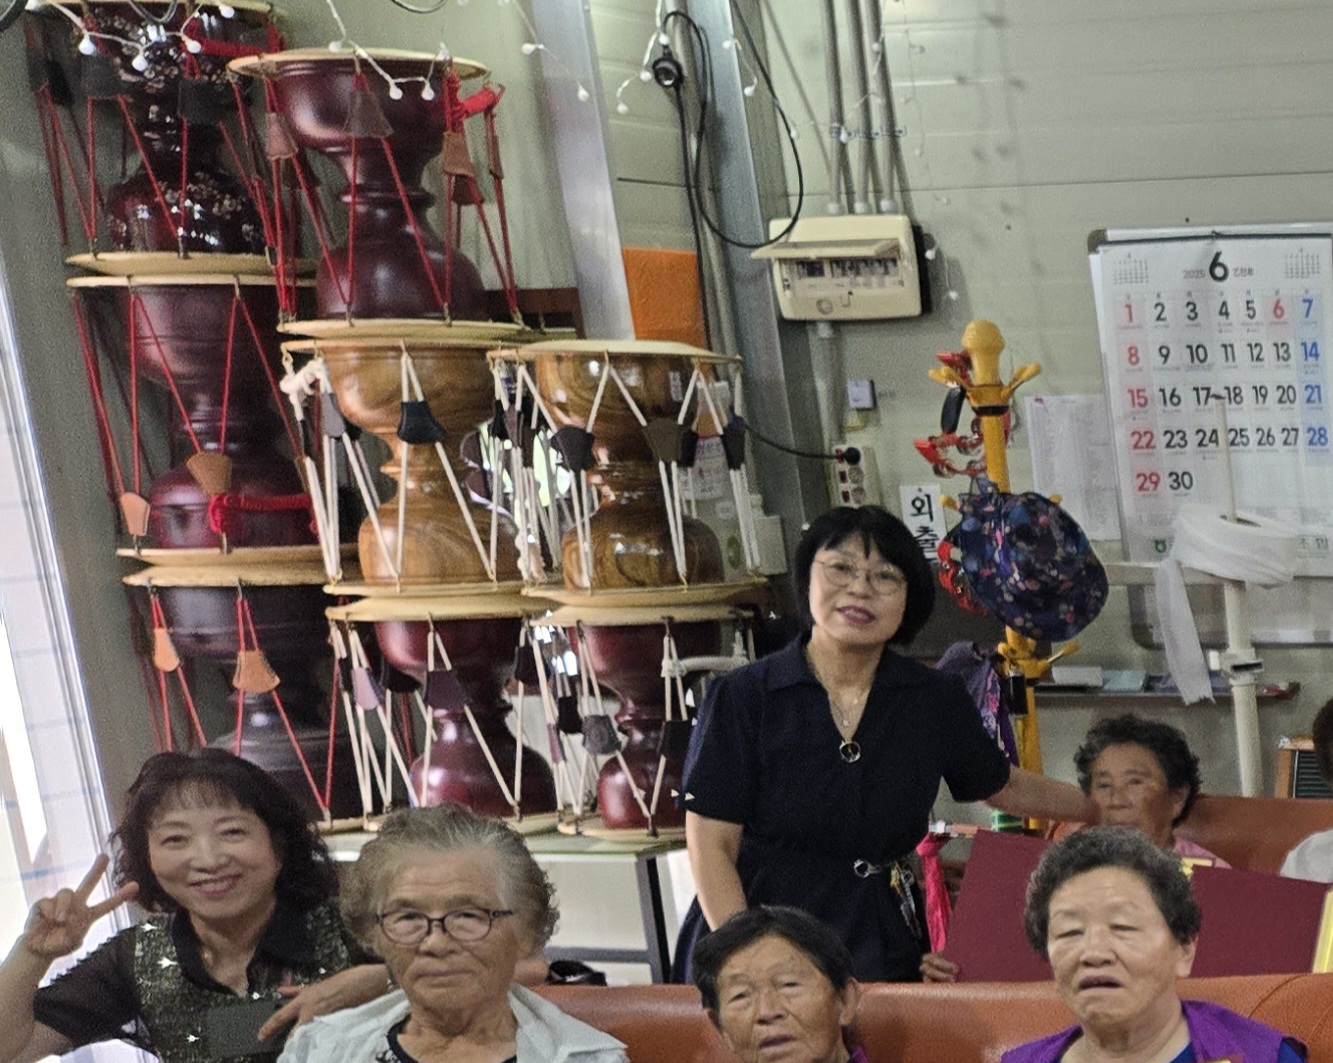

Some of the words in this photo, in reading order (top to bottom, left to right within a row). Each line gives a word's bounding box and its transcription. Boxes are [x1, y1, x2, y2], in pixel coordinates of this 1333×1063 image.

[1208, 251, 1229, 282] 6
[1125, 303, 1134, 322] 1
[1154, 303, 1167, 322] 2
[1186, 302, 1199, 321] 3
[1218, 302, 1230, 320] 4
[1246, 300, 1256, 319] 5
[1273, 299, 1285, 318] 6
[1302, 299, 1314, 318] 7
[1127, 346, 1140, 365] 8
[1158, 345, 1171, 364] 9
[1186, 344, 1208, 364] 10
[1221, 344, 1236, 363] 11
[1248, 343, 1264, 362] 12
[1273, 342, 1292, 362] 13
[1301, 342, 1320, 361] 14
[1127, 389, 1148, 408] 15
[1159, 388, 1181, 407] 16
[1193, 387, 1211, 406] 17
[1225, 386, 1244, 405] 18
[1253, 385, 1268, 404] 19
[1276, 385, 1297, 404] 20
[1305, 384, 1322, 404] 21
[1131, 431, 1156, 450] 22
[1163, 430, 1188, 449] 23
[1195, 429, 1219, 448] 24
[1229, 428, 1250, 447] 25
[1256, 428, 1276, 447] 26
[1281, 428, 1299, 446] 27
[1307, 427, 1328, 446] 28
[1136, 473, 1160, 492] 29
[1168, 471, 1194, 490] 30
